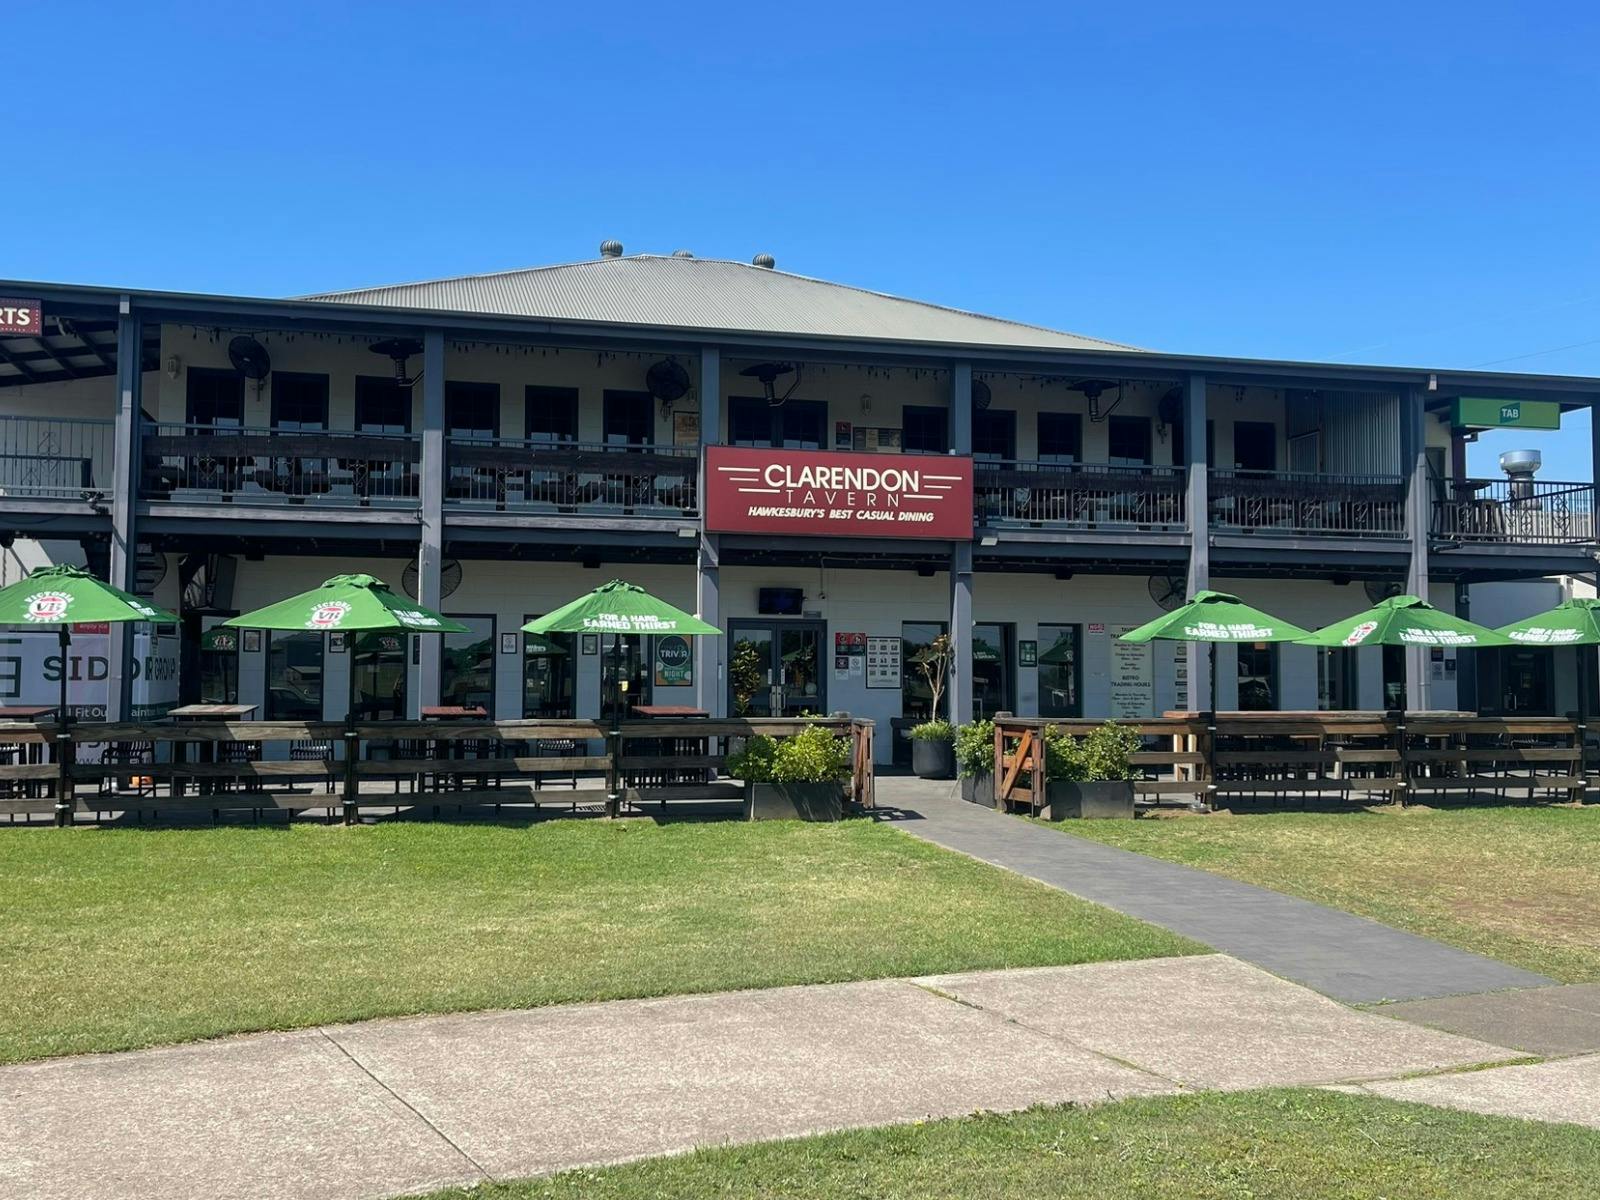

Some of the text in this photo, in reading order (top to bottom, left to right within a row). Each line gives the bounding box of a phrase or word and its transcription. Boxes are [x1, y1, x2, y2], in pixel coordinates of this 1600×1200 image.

[1501, 408, 1519, 418] TAB
[764, 464, 919, 493] CLARENDON
[785, 489, 899, 508] TAVERN
[748, 506, 935, 522] HAWKESBURY'S BEST CASUAL DINING
[598, 613, 618, 621] FOR
[583, 618, 677, 630] EARNED THIRST
[1198, 621, 1217, 630] FOR
[1184, 626, 1273, 639] EARNED THIRST
[660, 650, 688, 658] TRIVA
[75, 707, 90, 718] Fit
[91, 707, 108, 718] Ou
